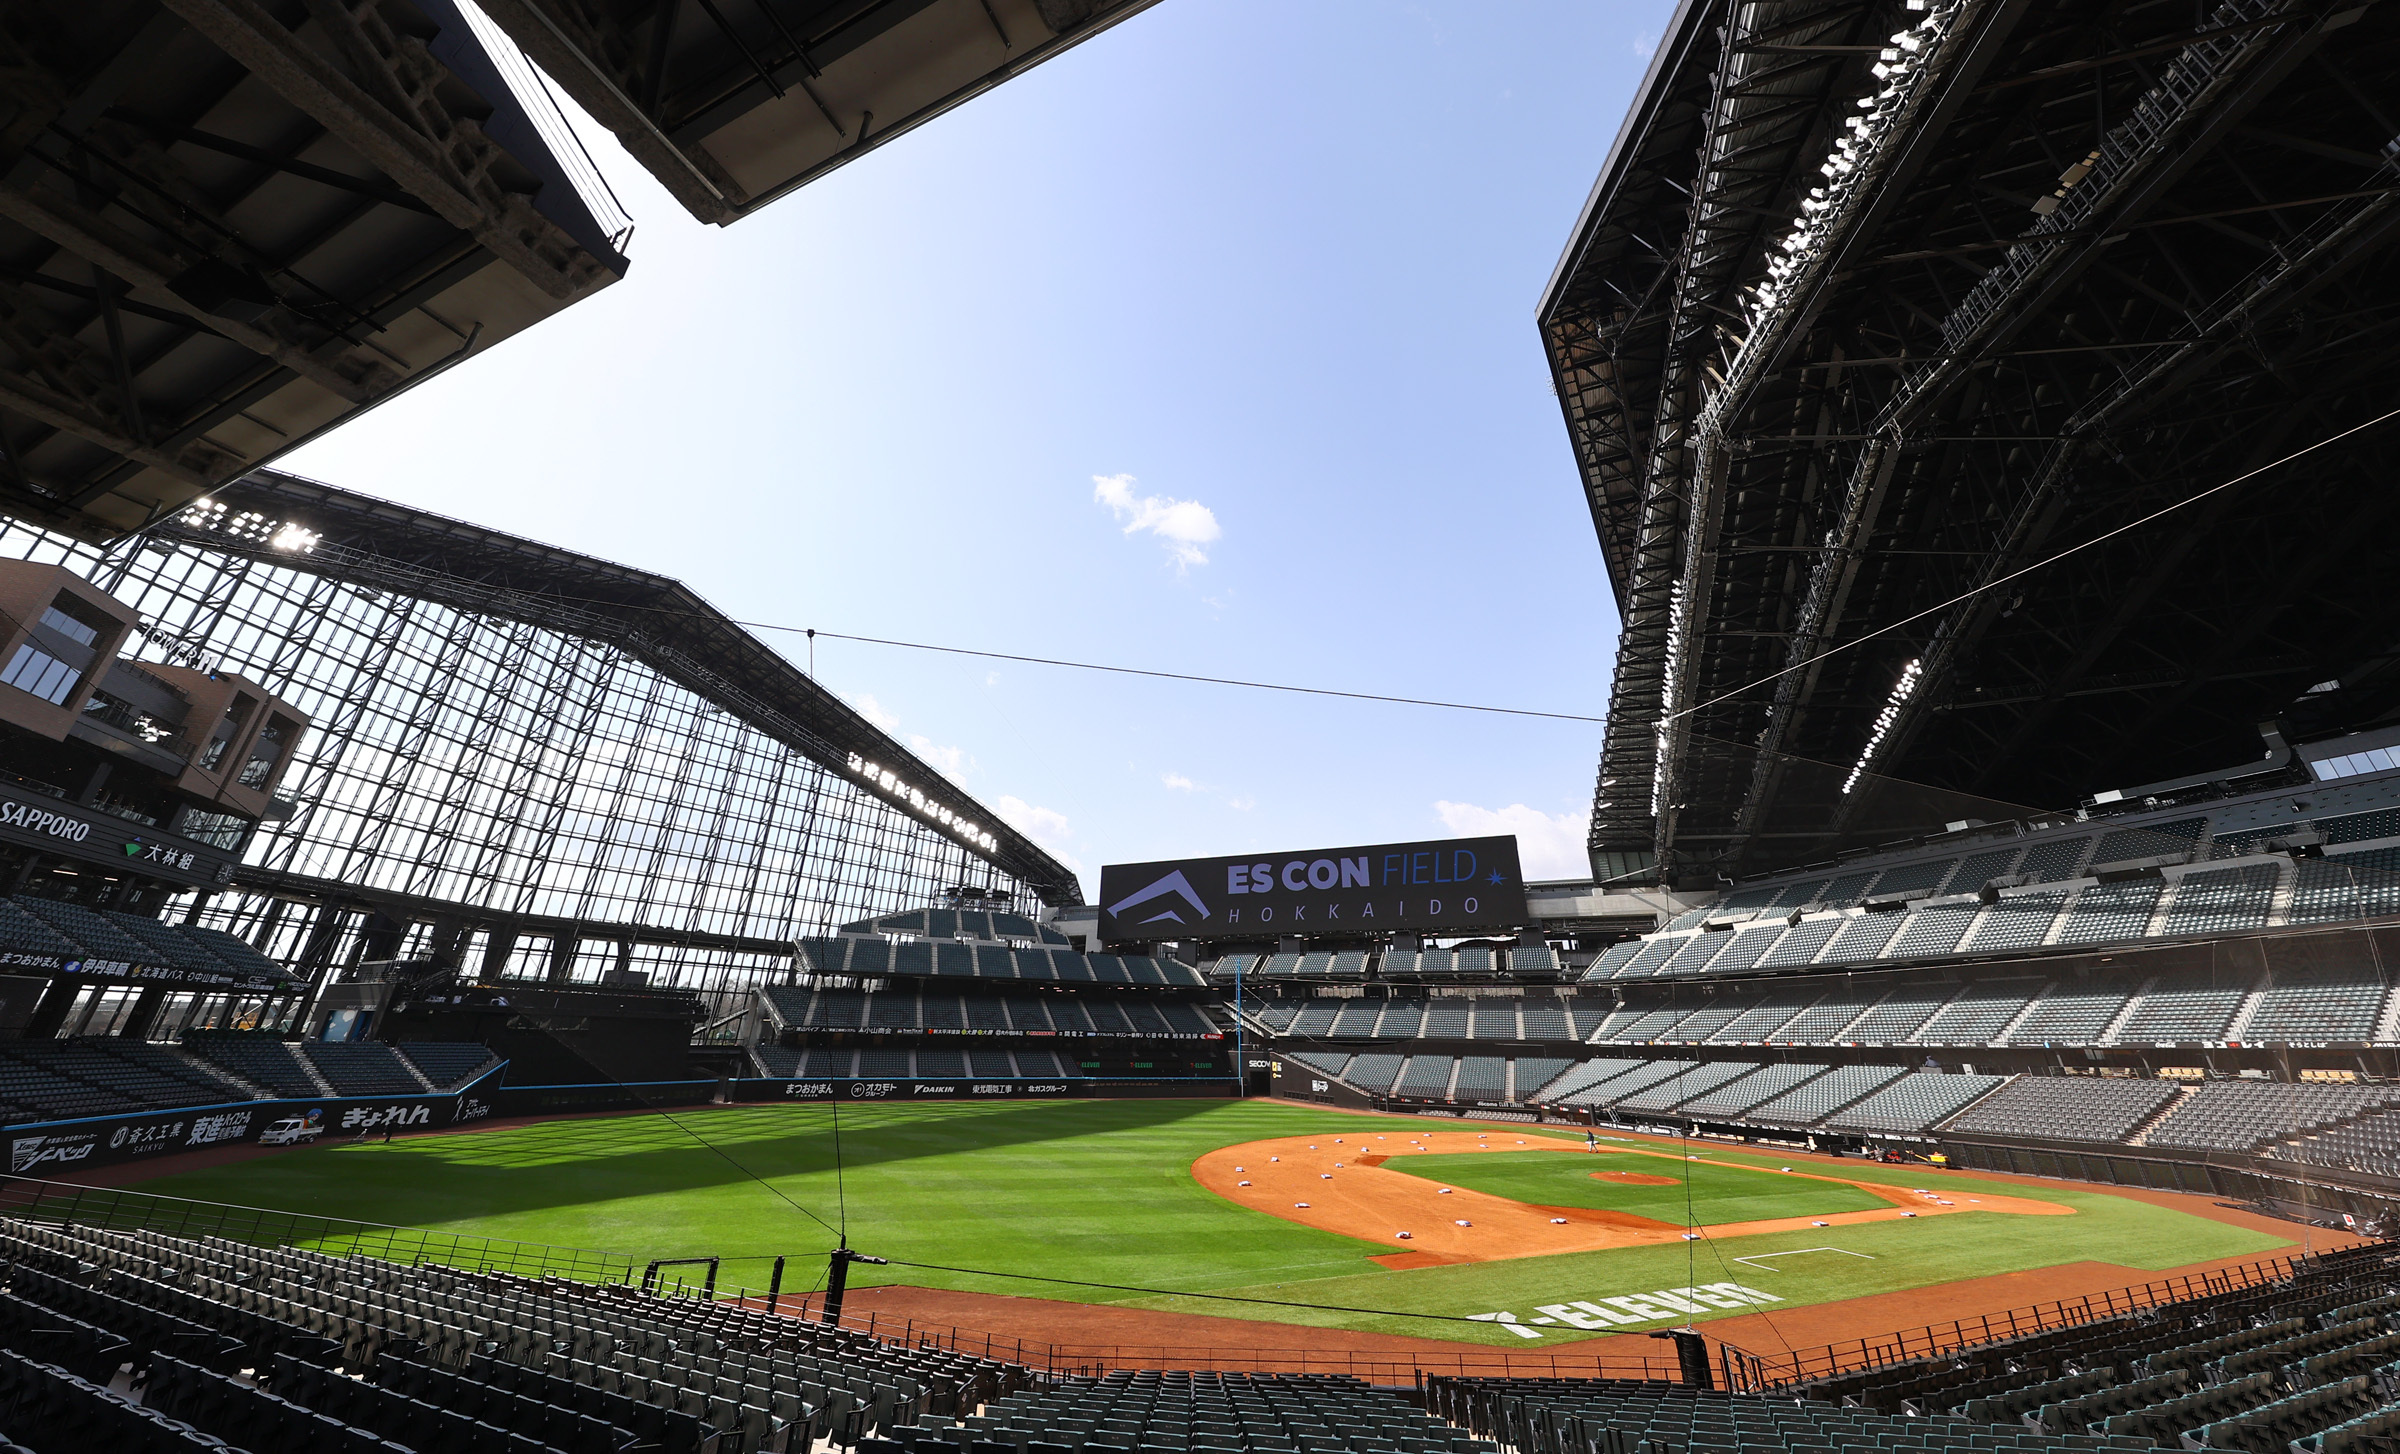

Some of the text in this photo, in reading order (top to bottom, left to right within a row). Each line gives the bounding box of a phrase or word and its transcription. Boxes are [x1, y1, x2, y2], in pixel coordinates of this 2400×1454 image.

[141, 623, 218, 675] TOWER 11
[0, 801, 90, 842] SAPPORO
[144, 843, 195, 871] 大林組
[1227, 850, 1476, 895] ES CON FIELD
[1228, 897, 1478, 923] HOKKAIDO
[141, 967, 184, 980] 北海道バス
[195, 974, 219, 983] 中山組
[865, 1083, 897, 1092] オカモト
[1028, 1085, 1067, 1093] 北ガスグループ
[341, 1104, 430, 1129] ぎょれん
[185, 1116, 226, 1146] 東進
[18, 1143, 95, 1172] ジーベック
[132, 1142, 165, 1154] SAIKYU
